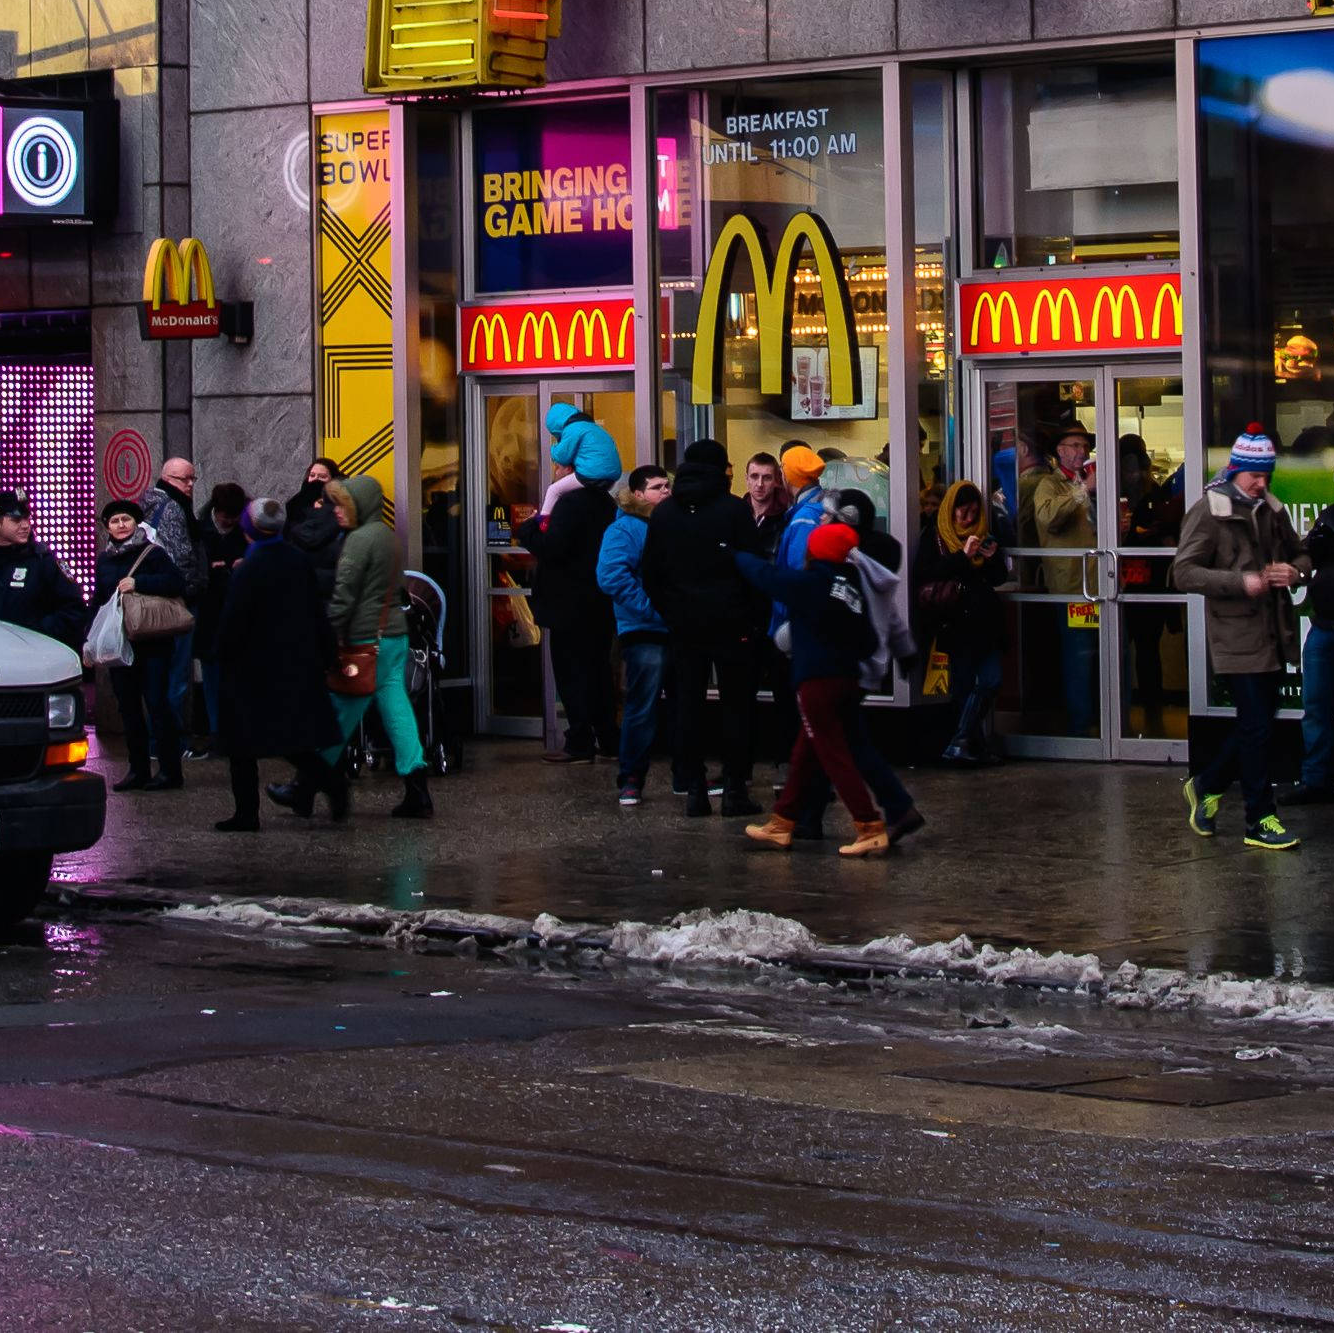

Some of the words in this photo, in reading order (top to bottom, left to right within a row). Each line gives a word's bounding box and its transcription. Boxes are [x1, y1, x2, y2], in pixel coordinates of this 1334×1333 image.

[726, 108, 829, 136] BREAKFAST
[702, 140, 758, 165] UNTIL
[770, 135, 820, 160] 11:00
[827, 132, 857, 155] AM
[483, 163, 628, 204] BRINGING
[484, 201, 584, 239] GAME
[151, 315, 219, 327] McDonald's
